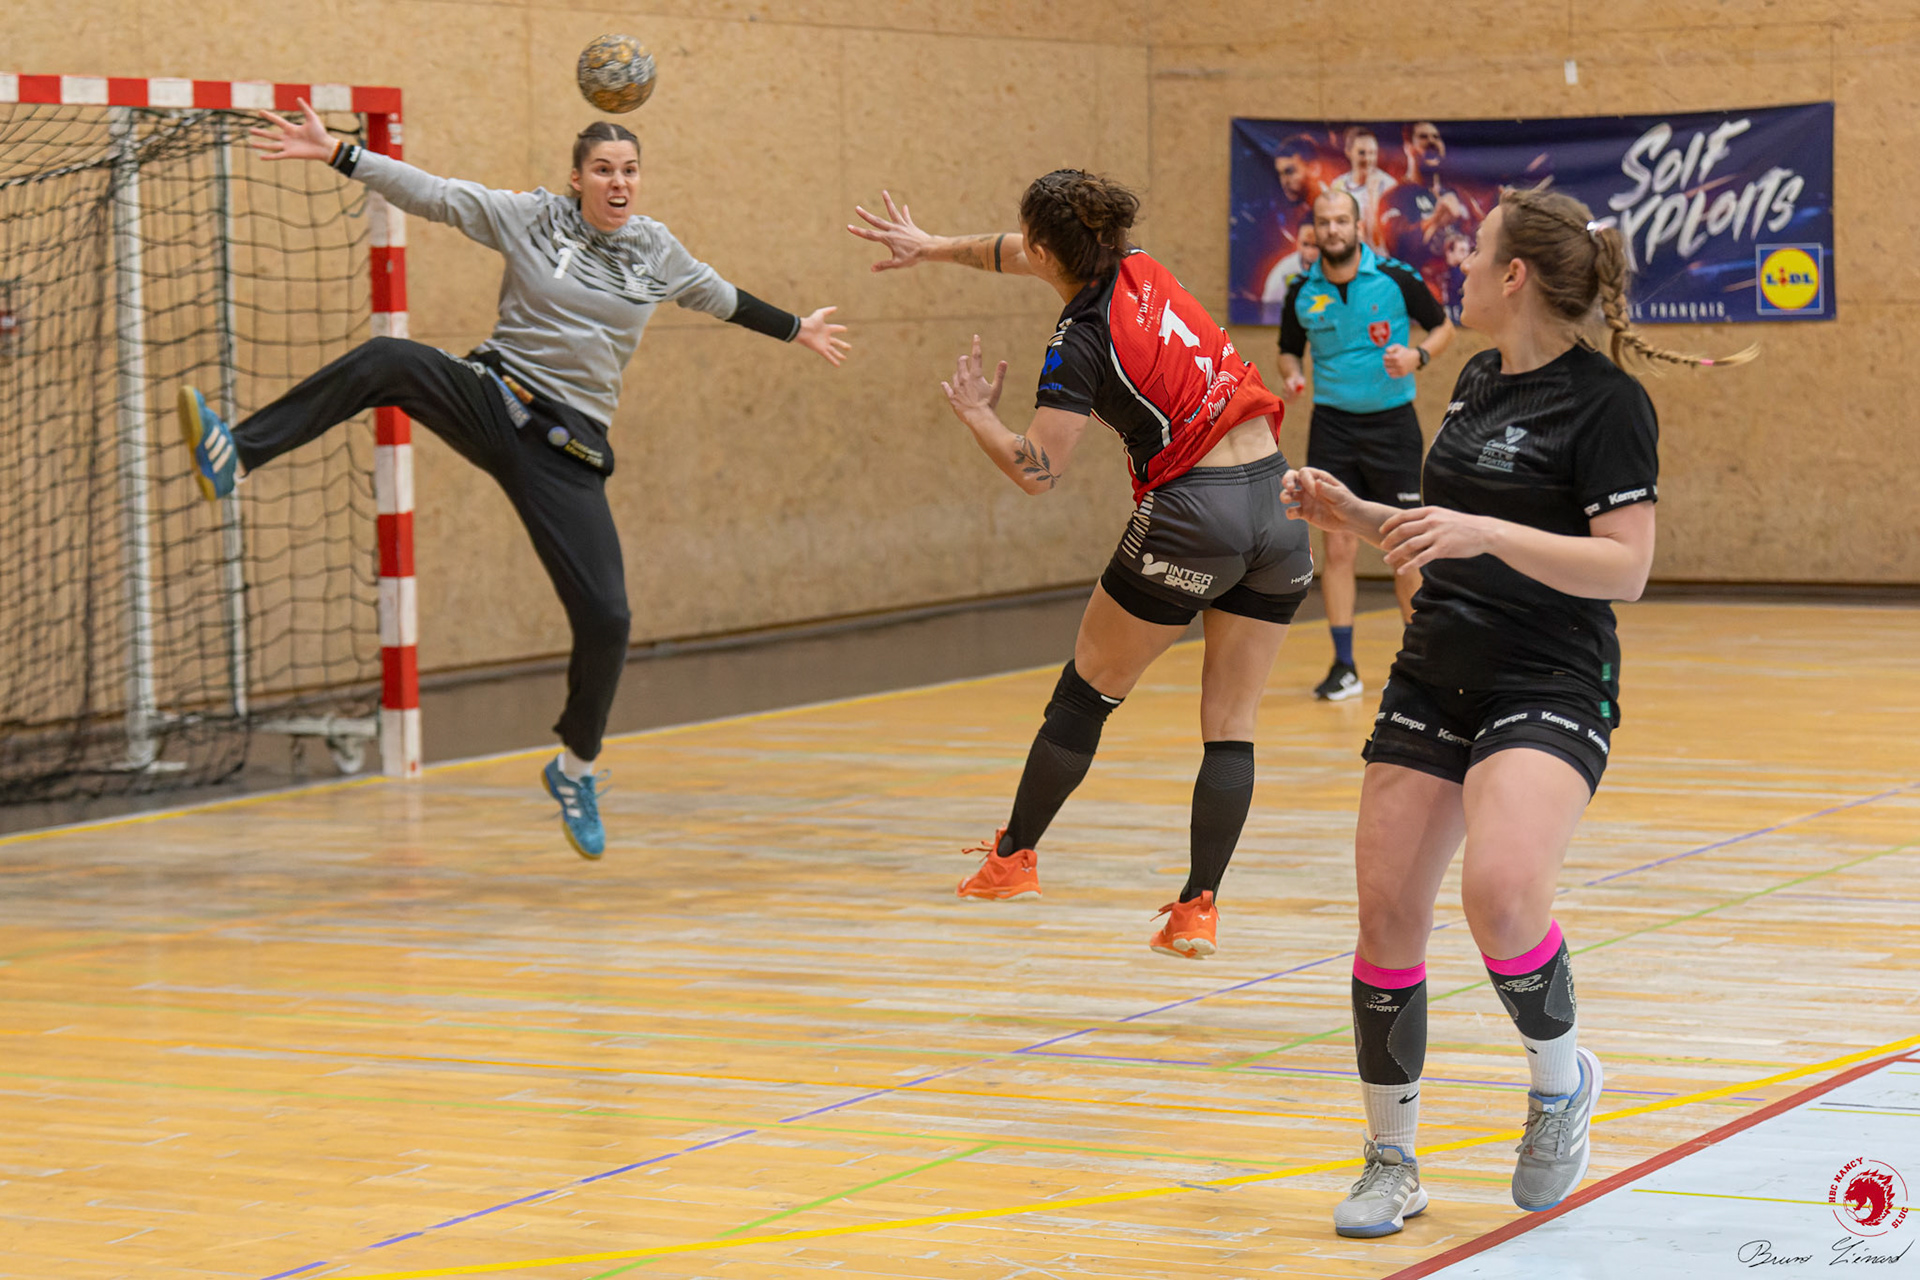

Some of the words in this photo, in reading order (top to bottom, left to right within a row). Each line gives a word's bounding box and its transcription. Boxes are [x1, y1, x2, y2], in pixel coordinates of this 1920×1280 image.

[553, 247, 573, 280] 1
[1608, 488, 1647, 505] Kempa
[1164, 574, 1209, 595] SPORT
[1168, 564, 1213, 585] INTER
[1391, 712, 1426, 731] Kempa
[1541, 711, 1579, 731] Kempa
